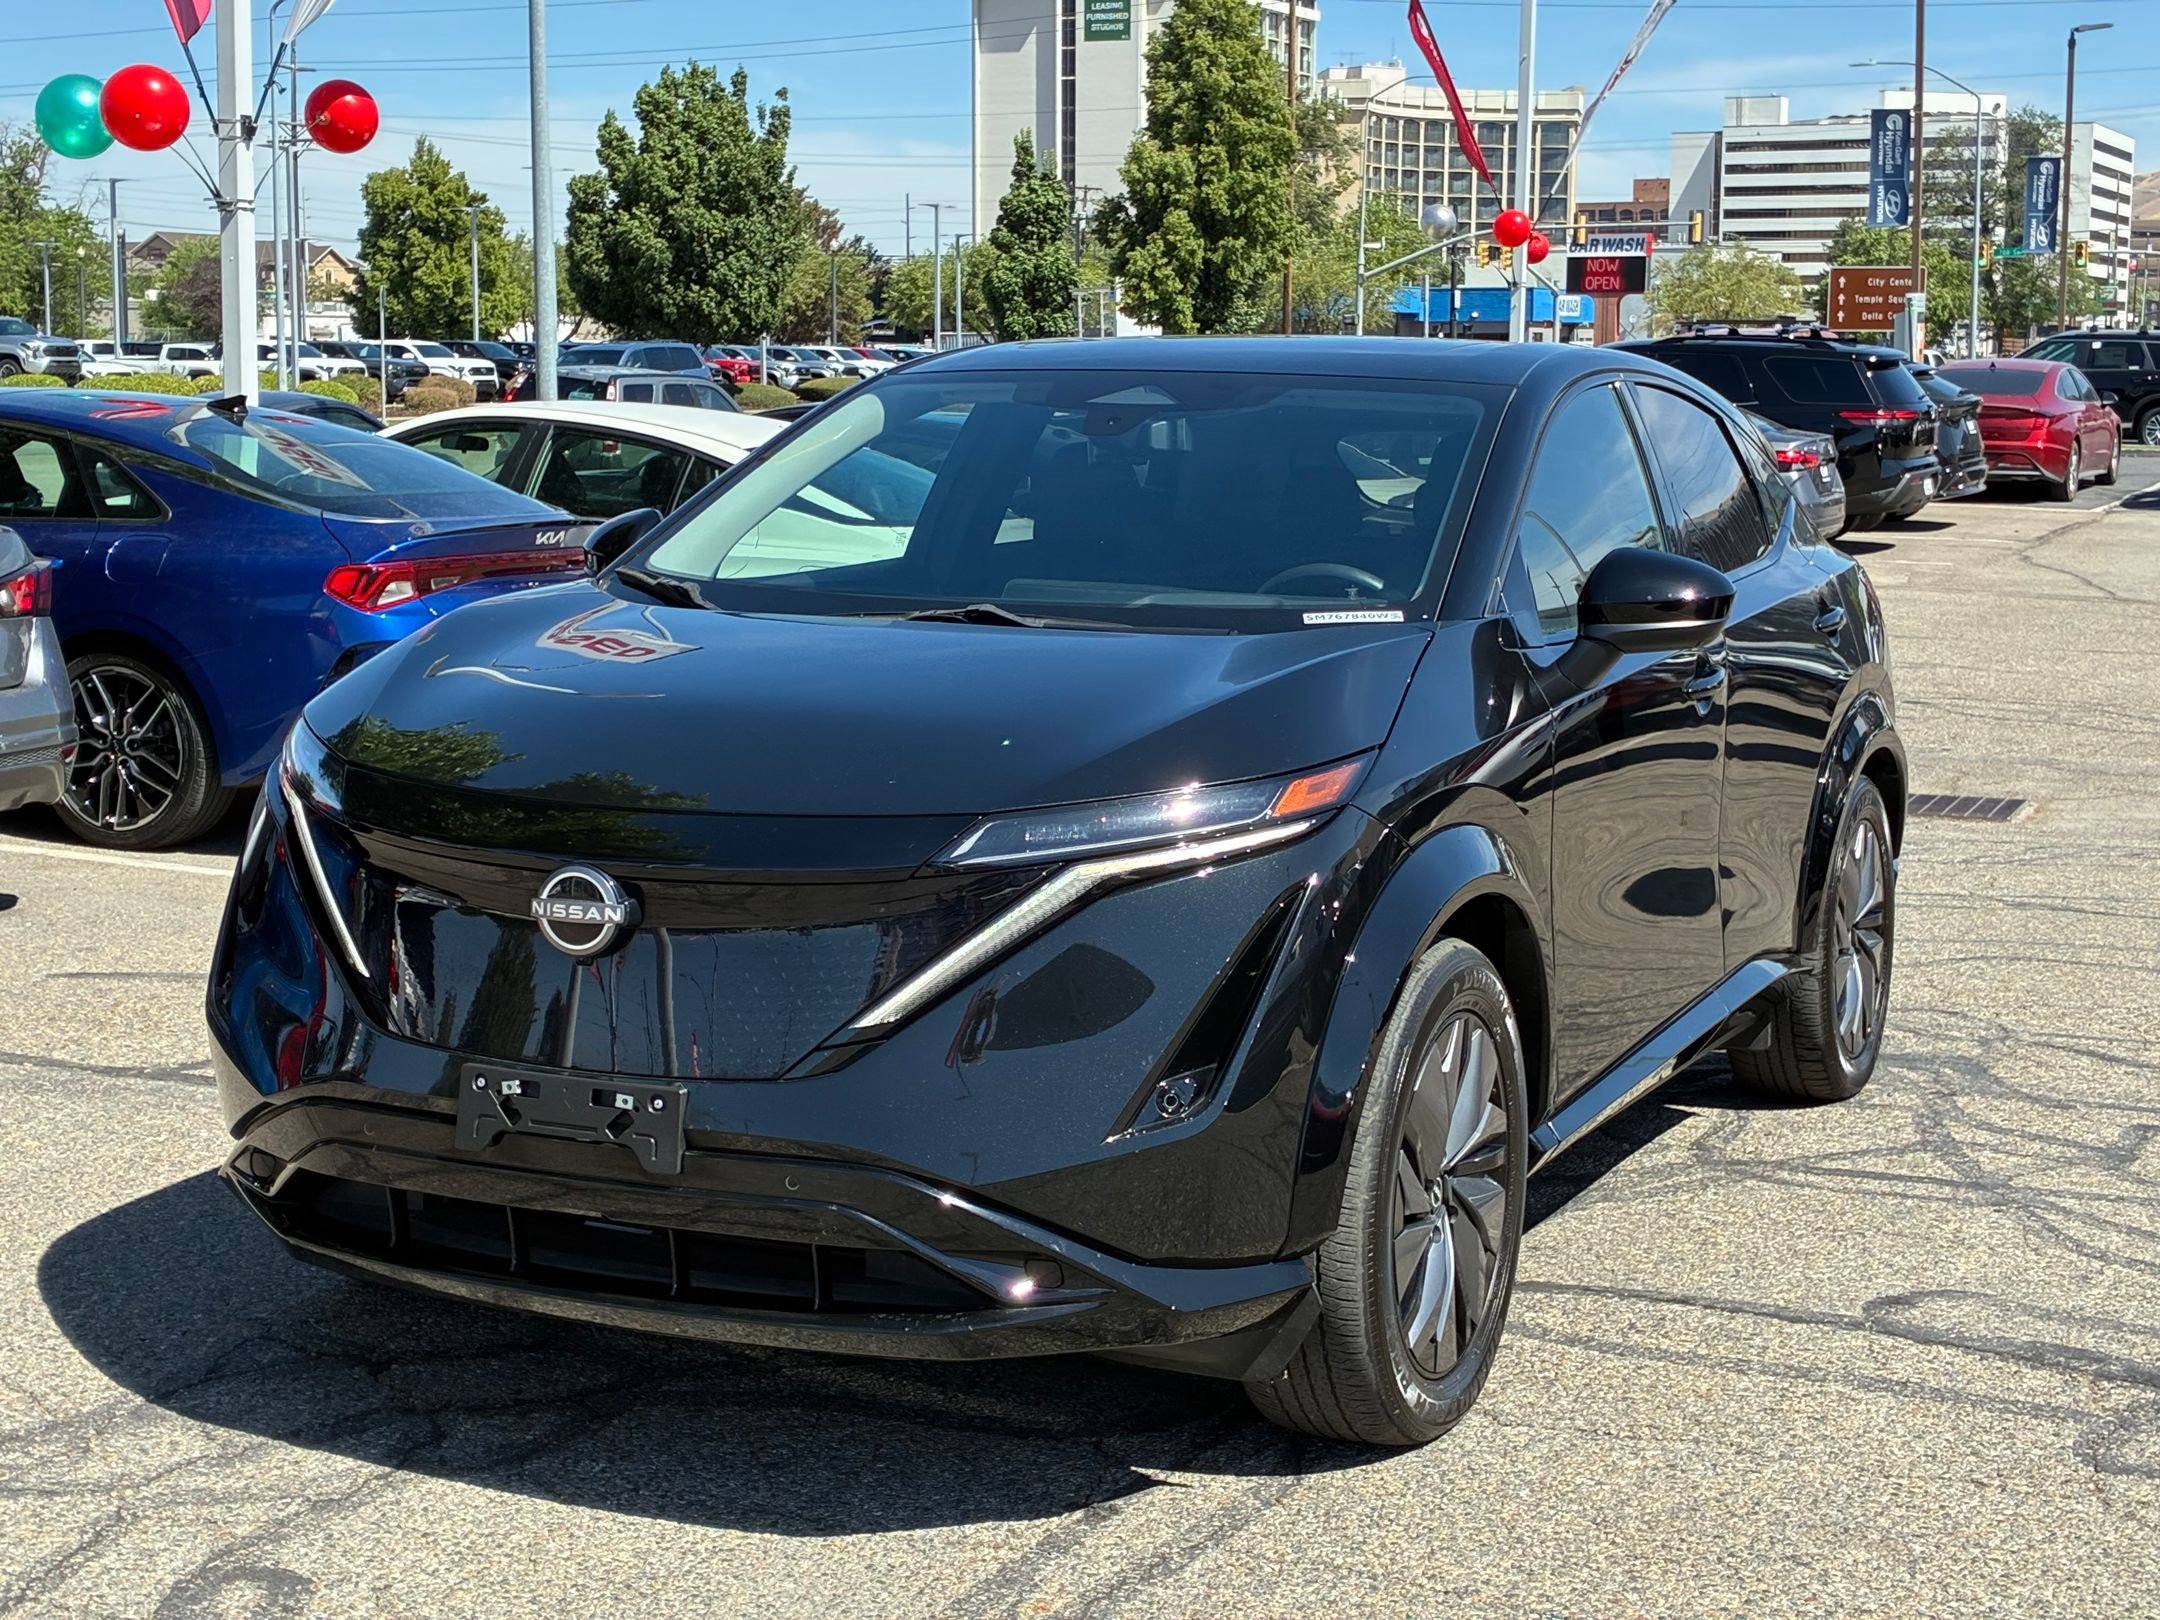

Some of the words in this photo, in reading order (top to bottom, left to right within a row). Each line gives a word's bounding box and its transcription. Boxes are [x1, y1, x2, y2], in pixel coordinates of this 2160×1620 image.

[1091, 2, 1123, 10] LEASING
[1086, 13, 1129, 21] FURNISHED
[1091, 23, 1124, 31] STUDIOS
[1884, 131, 1894, 174] Hyundai
[1876, 185, 1884, 223] HYUNDAI
[1602, 237, 1645, 252] WASH
[1587, 258, 1620, 272] NOW
[1585, 276, 1620, 290] OPEN
[1867, 277, 1885, 288] City
[1889, 277, 1912, 287] Cente
[1854, 294, 1883, 305] Temple
[1862, 311, 1883, 321] Delta
[535, 530, 566, 546] KIA
[531, 900, 622, 922] NISSAN
